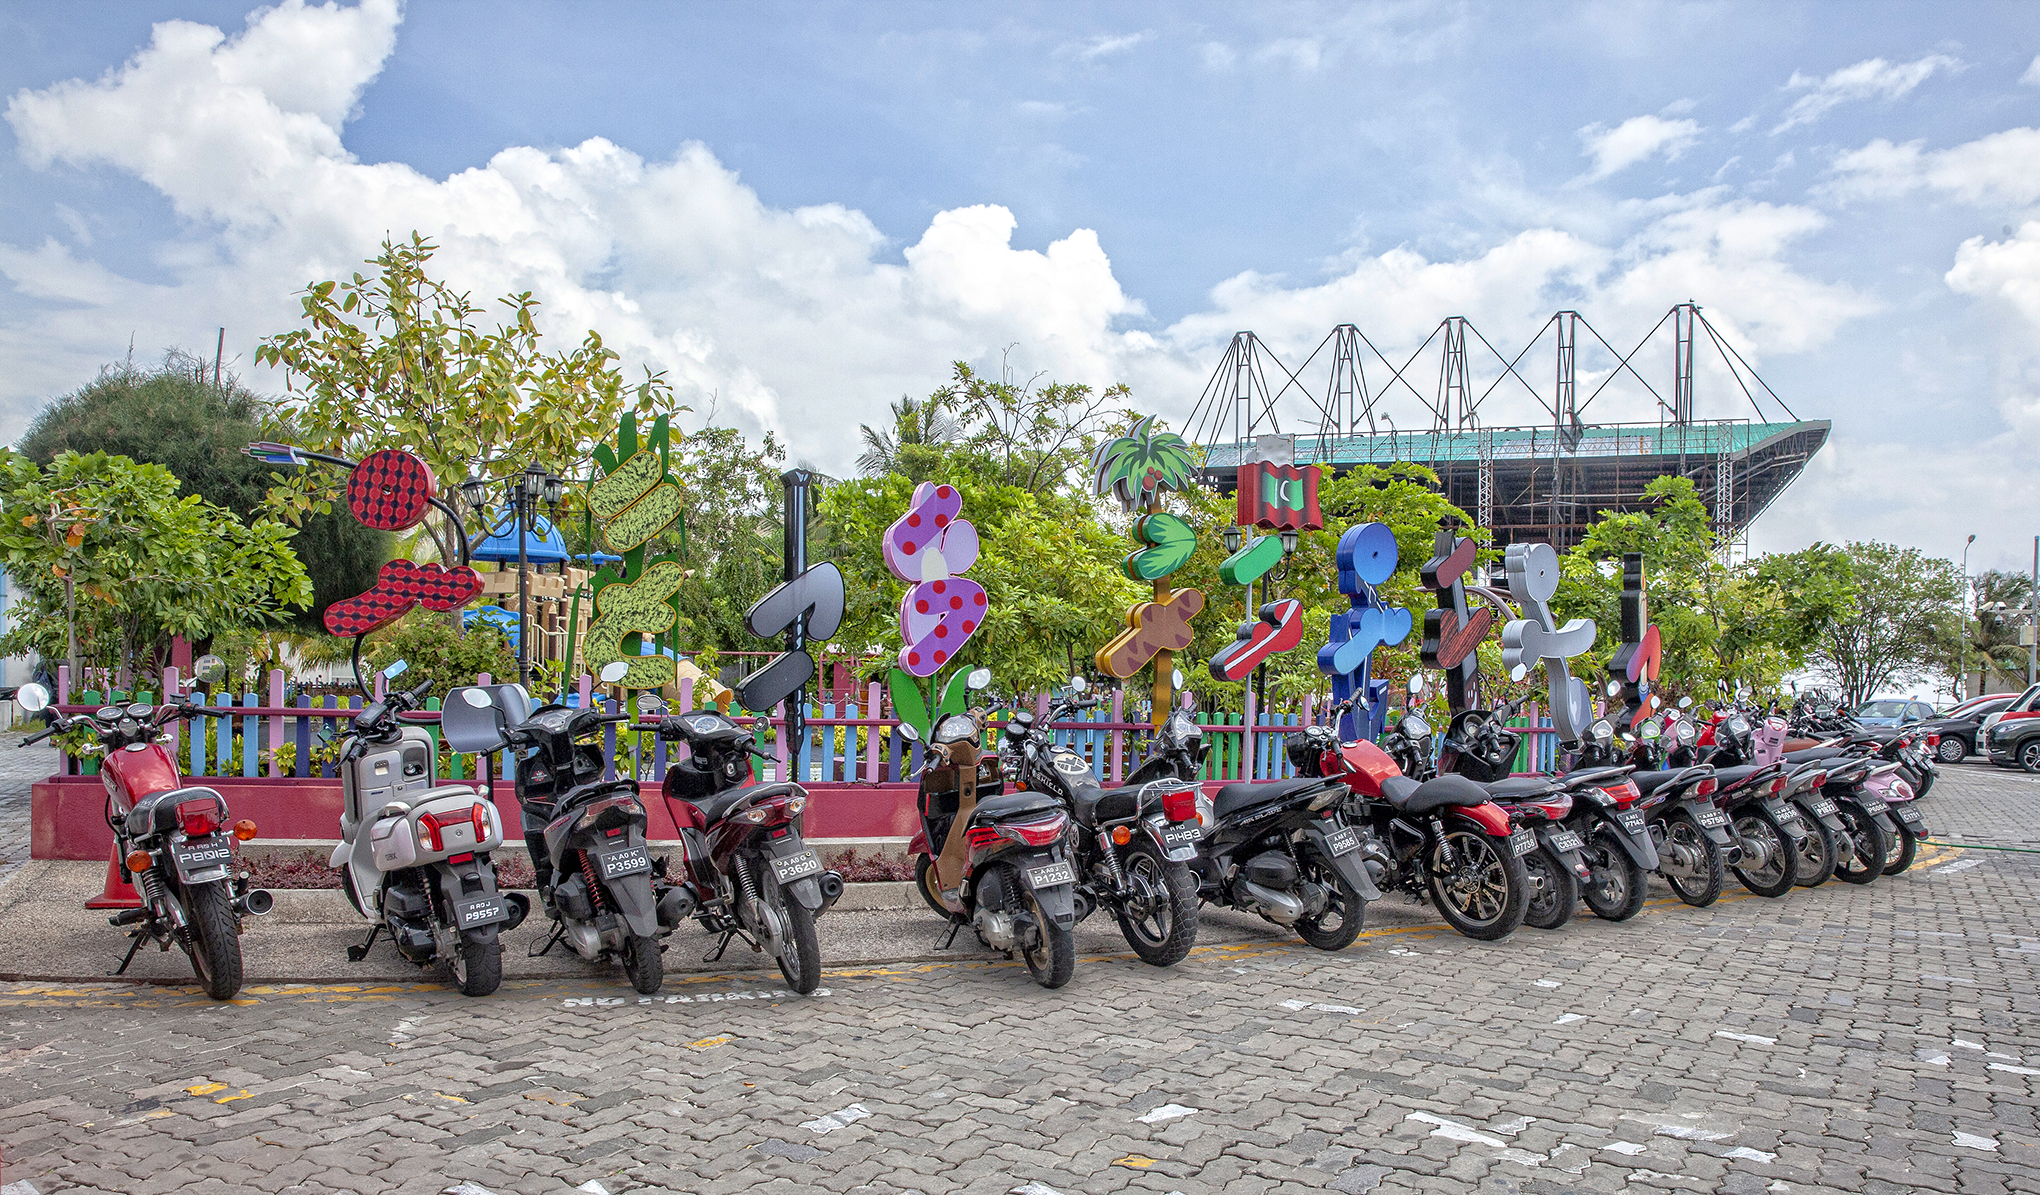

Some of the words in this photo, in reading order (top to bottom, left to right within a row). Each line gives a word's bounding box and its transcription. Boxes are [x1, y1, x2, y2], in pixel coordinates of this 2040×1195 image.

[1624, 818, 1644, 828] P7143
[1165, 828, 1201, 844] P1483
[1558, 838, 1580, 849] C8321
[1333, 837, 1354, 852] P9585
[179, 848, 230, 863] P8012
[606, 857, 646, 874] P3599
[779, 859, 817, 879] P3620
[1035, 871, 1070, 884] P1232
[465, 907, 499, 922] P9557
